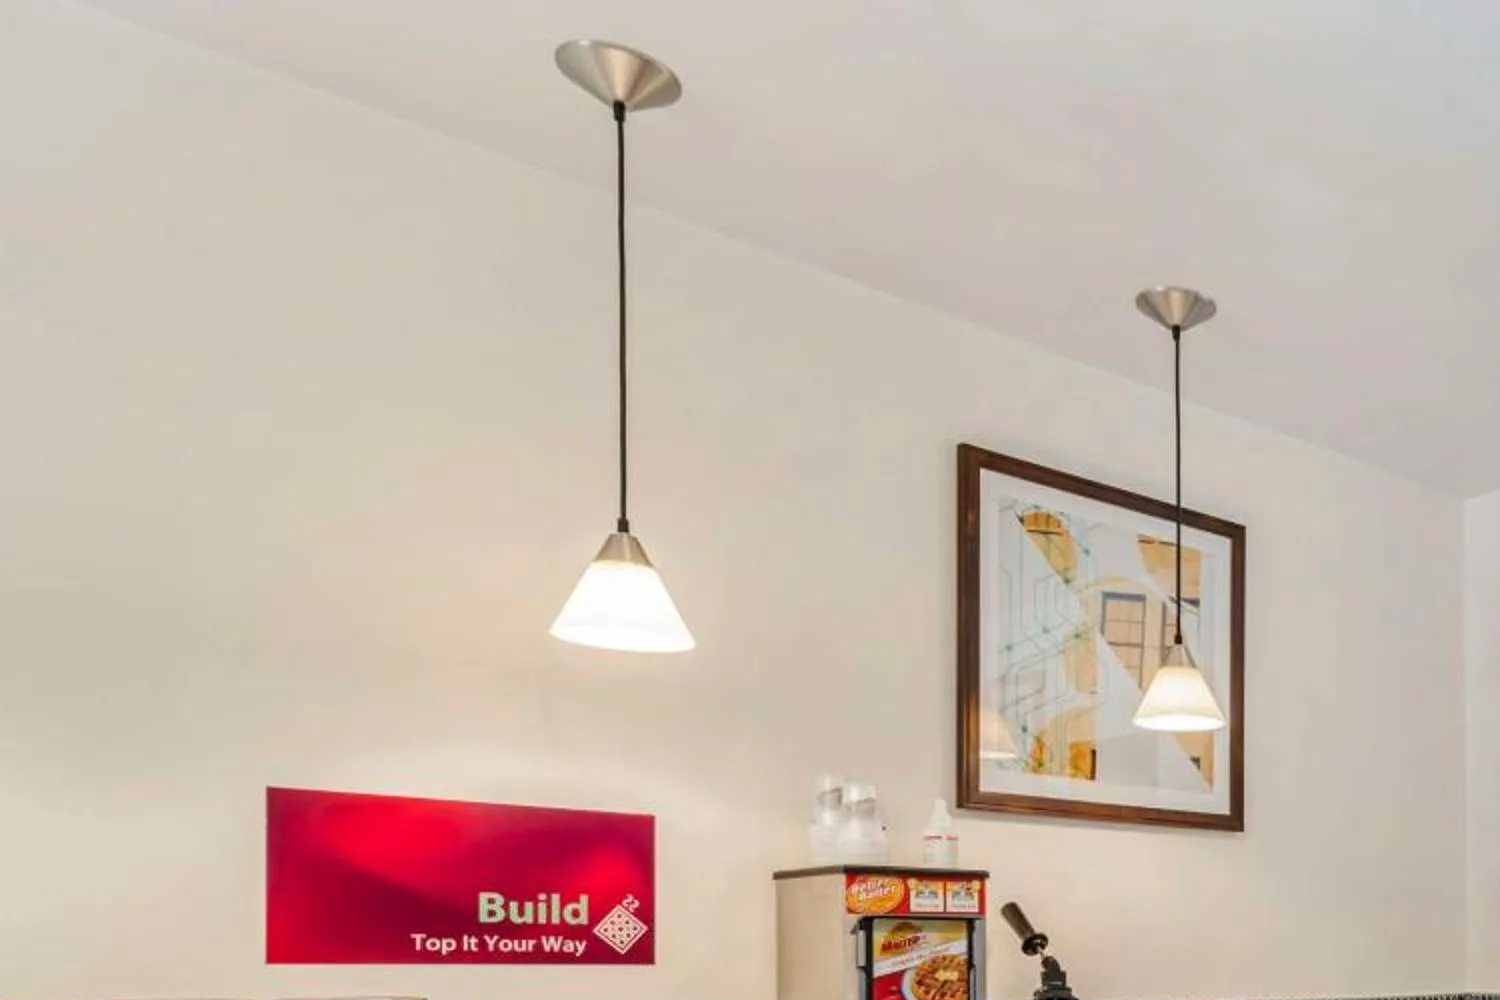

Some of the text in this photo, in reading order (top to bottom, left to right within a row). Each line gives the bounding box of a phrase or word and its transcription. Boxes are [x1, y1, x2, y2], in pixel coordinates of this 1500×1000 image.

[478, 891, 589, 926] Build
[410, 933, 587, 957] Top It Your Way
